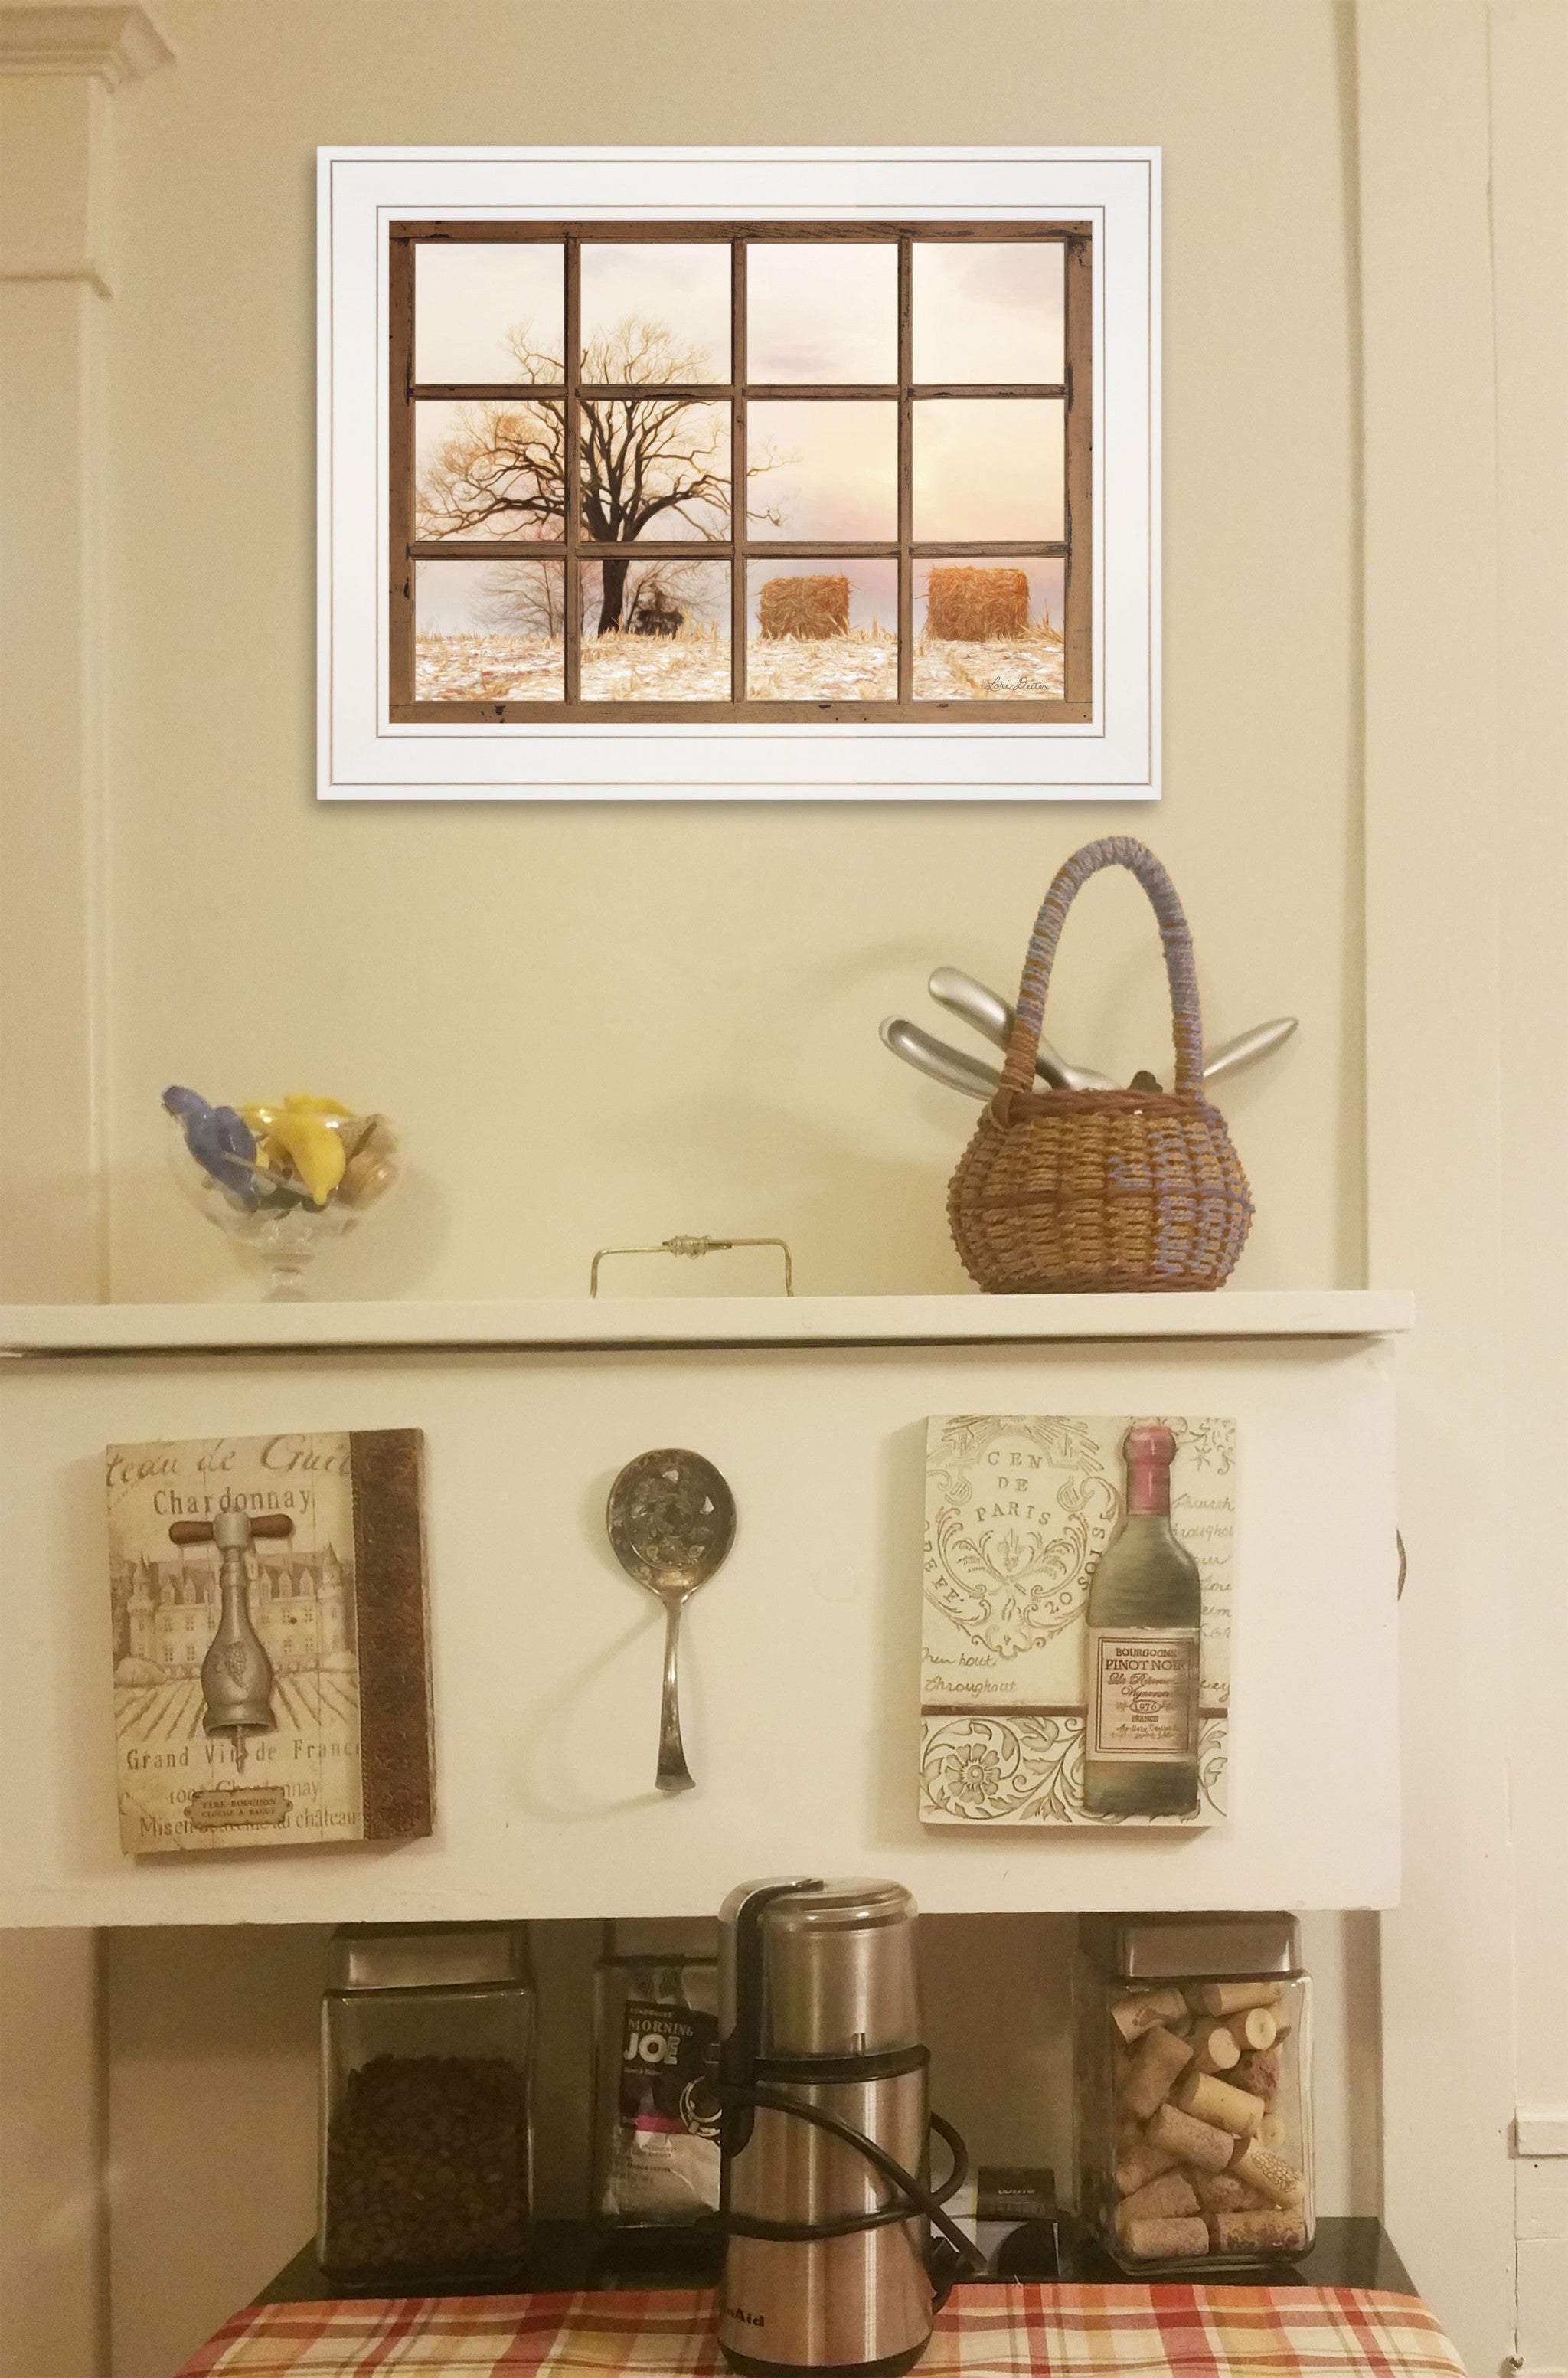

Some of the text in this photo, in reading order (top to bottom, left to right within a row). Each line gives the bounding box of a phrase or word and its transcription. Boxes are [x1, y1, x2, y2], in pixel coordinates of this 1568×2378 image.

[998, 1477, 1028, 1492] DE
[153, 1487, 310, 1516] Chardonnay
[975, 1501, 1050, 1525] PARIS
[1106, 1659, 1186, 1671] PINOT NOIR
[1133, 1703, 1158, 1712] 1976
[1131, 1715, 1159, 1723] FRANCE
[126, 1747, 189, 1771] Grand
[255, 1742, 277, 1761] de
[628, 2018, 694, 2037] MORNING
[623, 2032, 681, 2066] JOE
